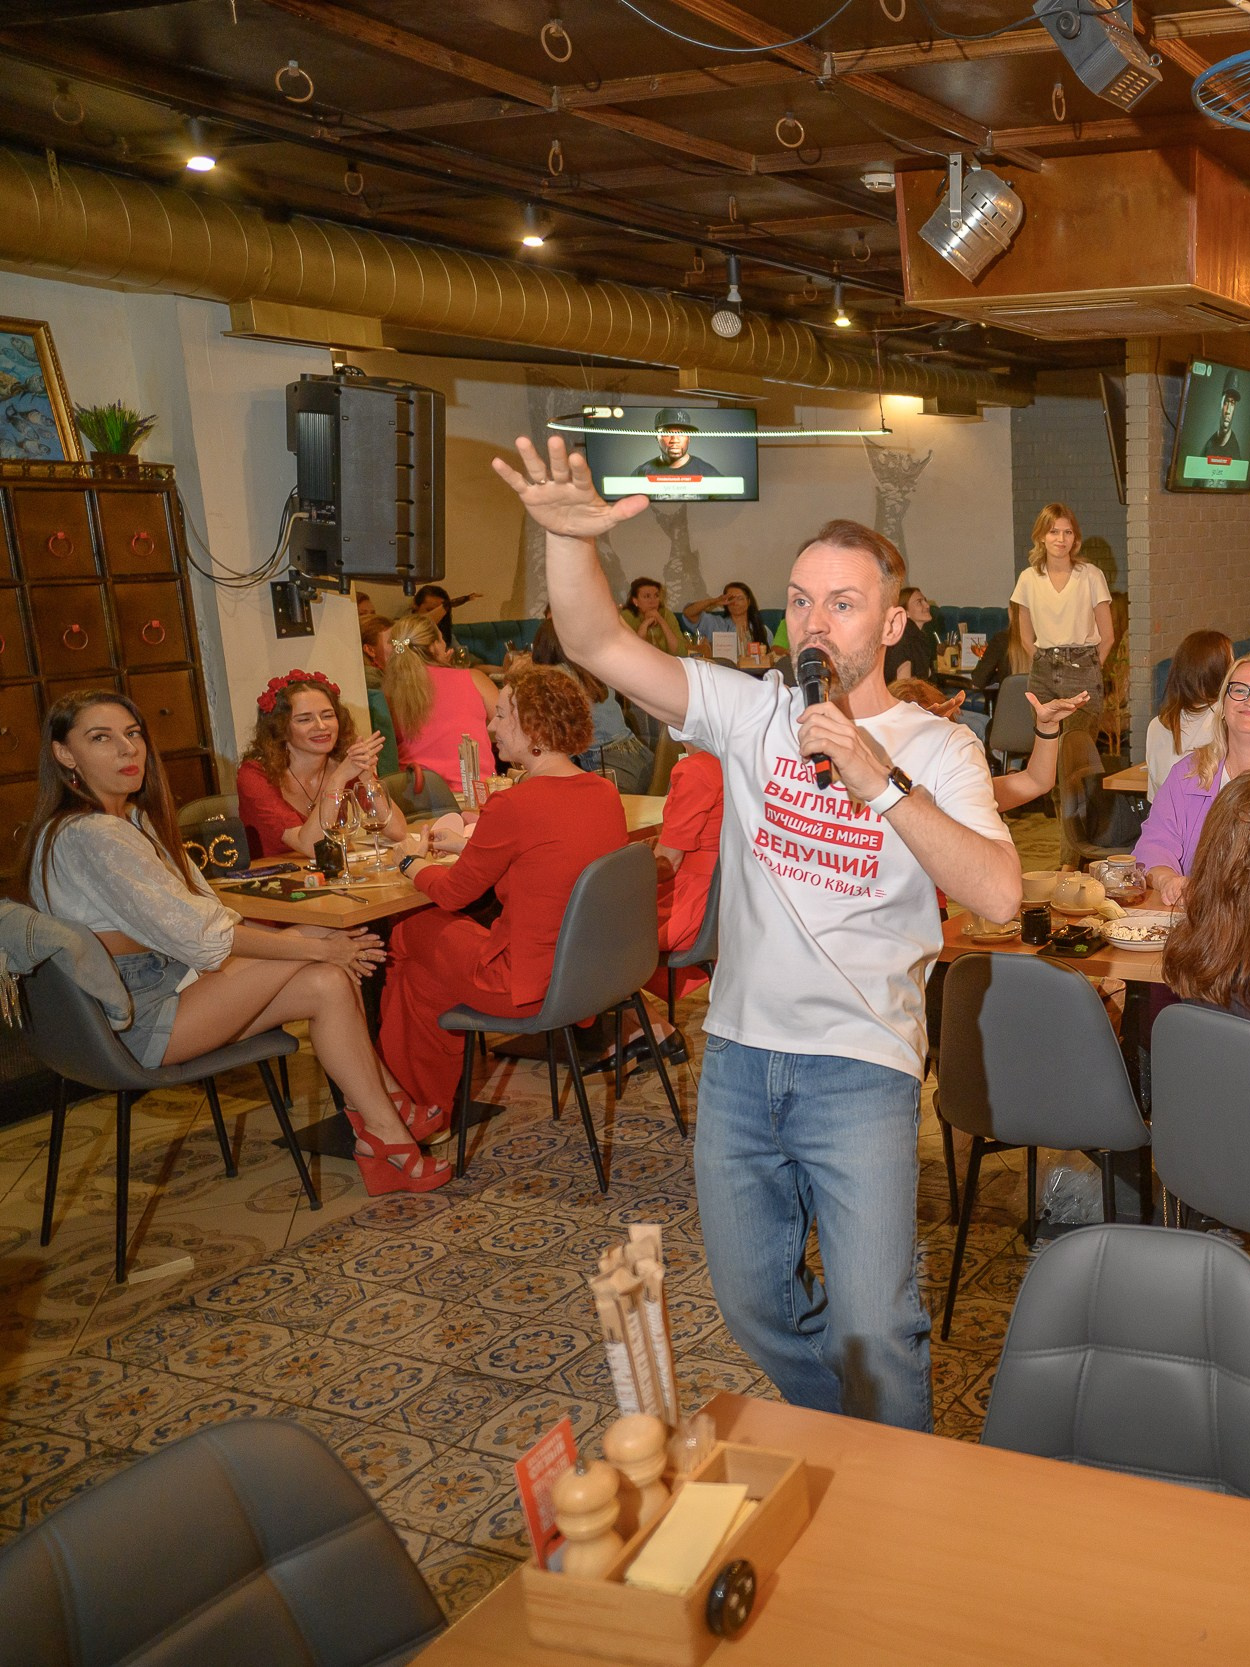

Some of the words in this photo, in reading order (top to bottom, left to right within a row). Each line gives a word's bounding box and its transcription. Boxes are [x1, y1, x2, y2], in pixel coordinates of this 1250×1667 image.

[767, 807, 823, 838] ЛУЧШИЙ
[824, 827, 835, 840] В
[836, 831, 879, 847] МИРЕ
[752, 848, 821, 887] МОДНОГО
[824, 877, 871, 898] КВИЗА
[754, 827, 880, 879] ВЕДУЩИЙ
